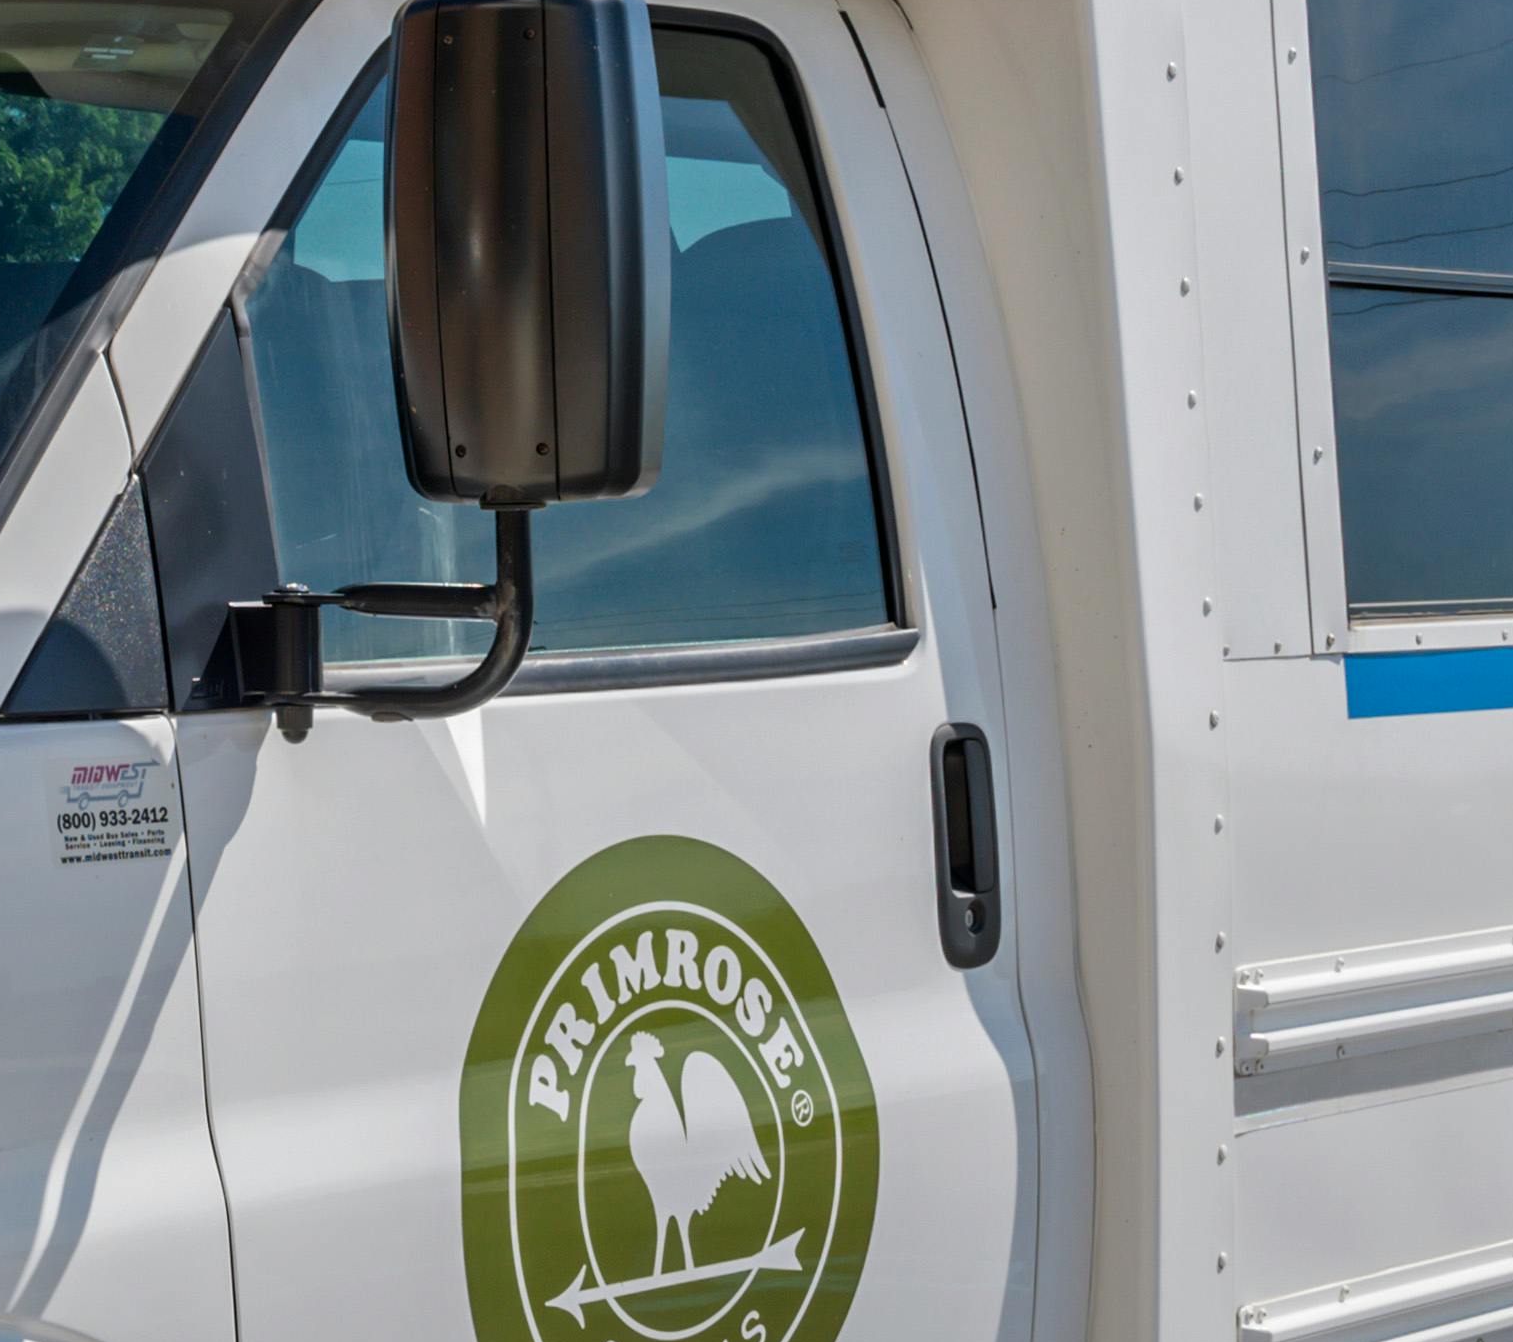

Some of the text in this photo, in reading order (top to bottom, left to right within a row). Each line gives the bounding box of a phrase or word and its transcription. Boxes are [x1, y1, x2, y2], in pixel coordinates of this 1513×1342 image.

[57, 807, 169, 834] (800) 933-2412
[60, 848, 172, 864] www.midwesttransit.com
